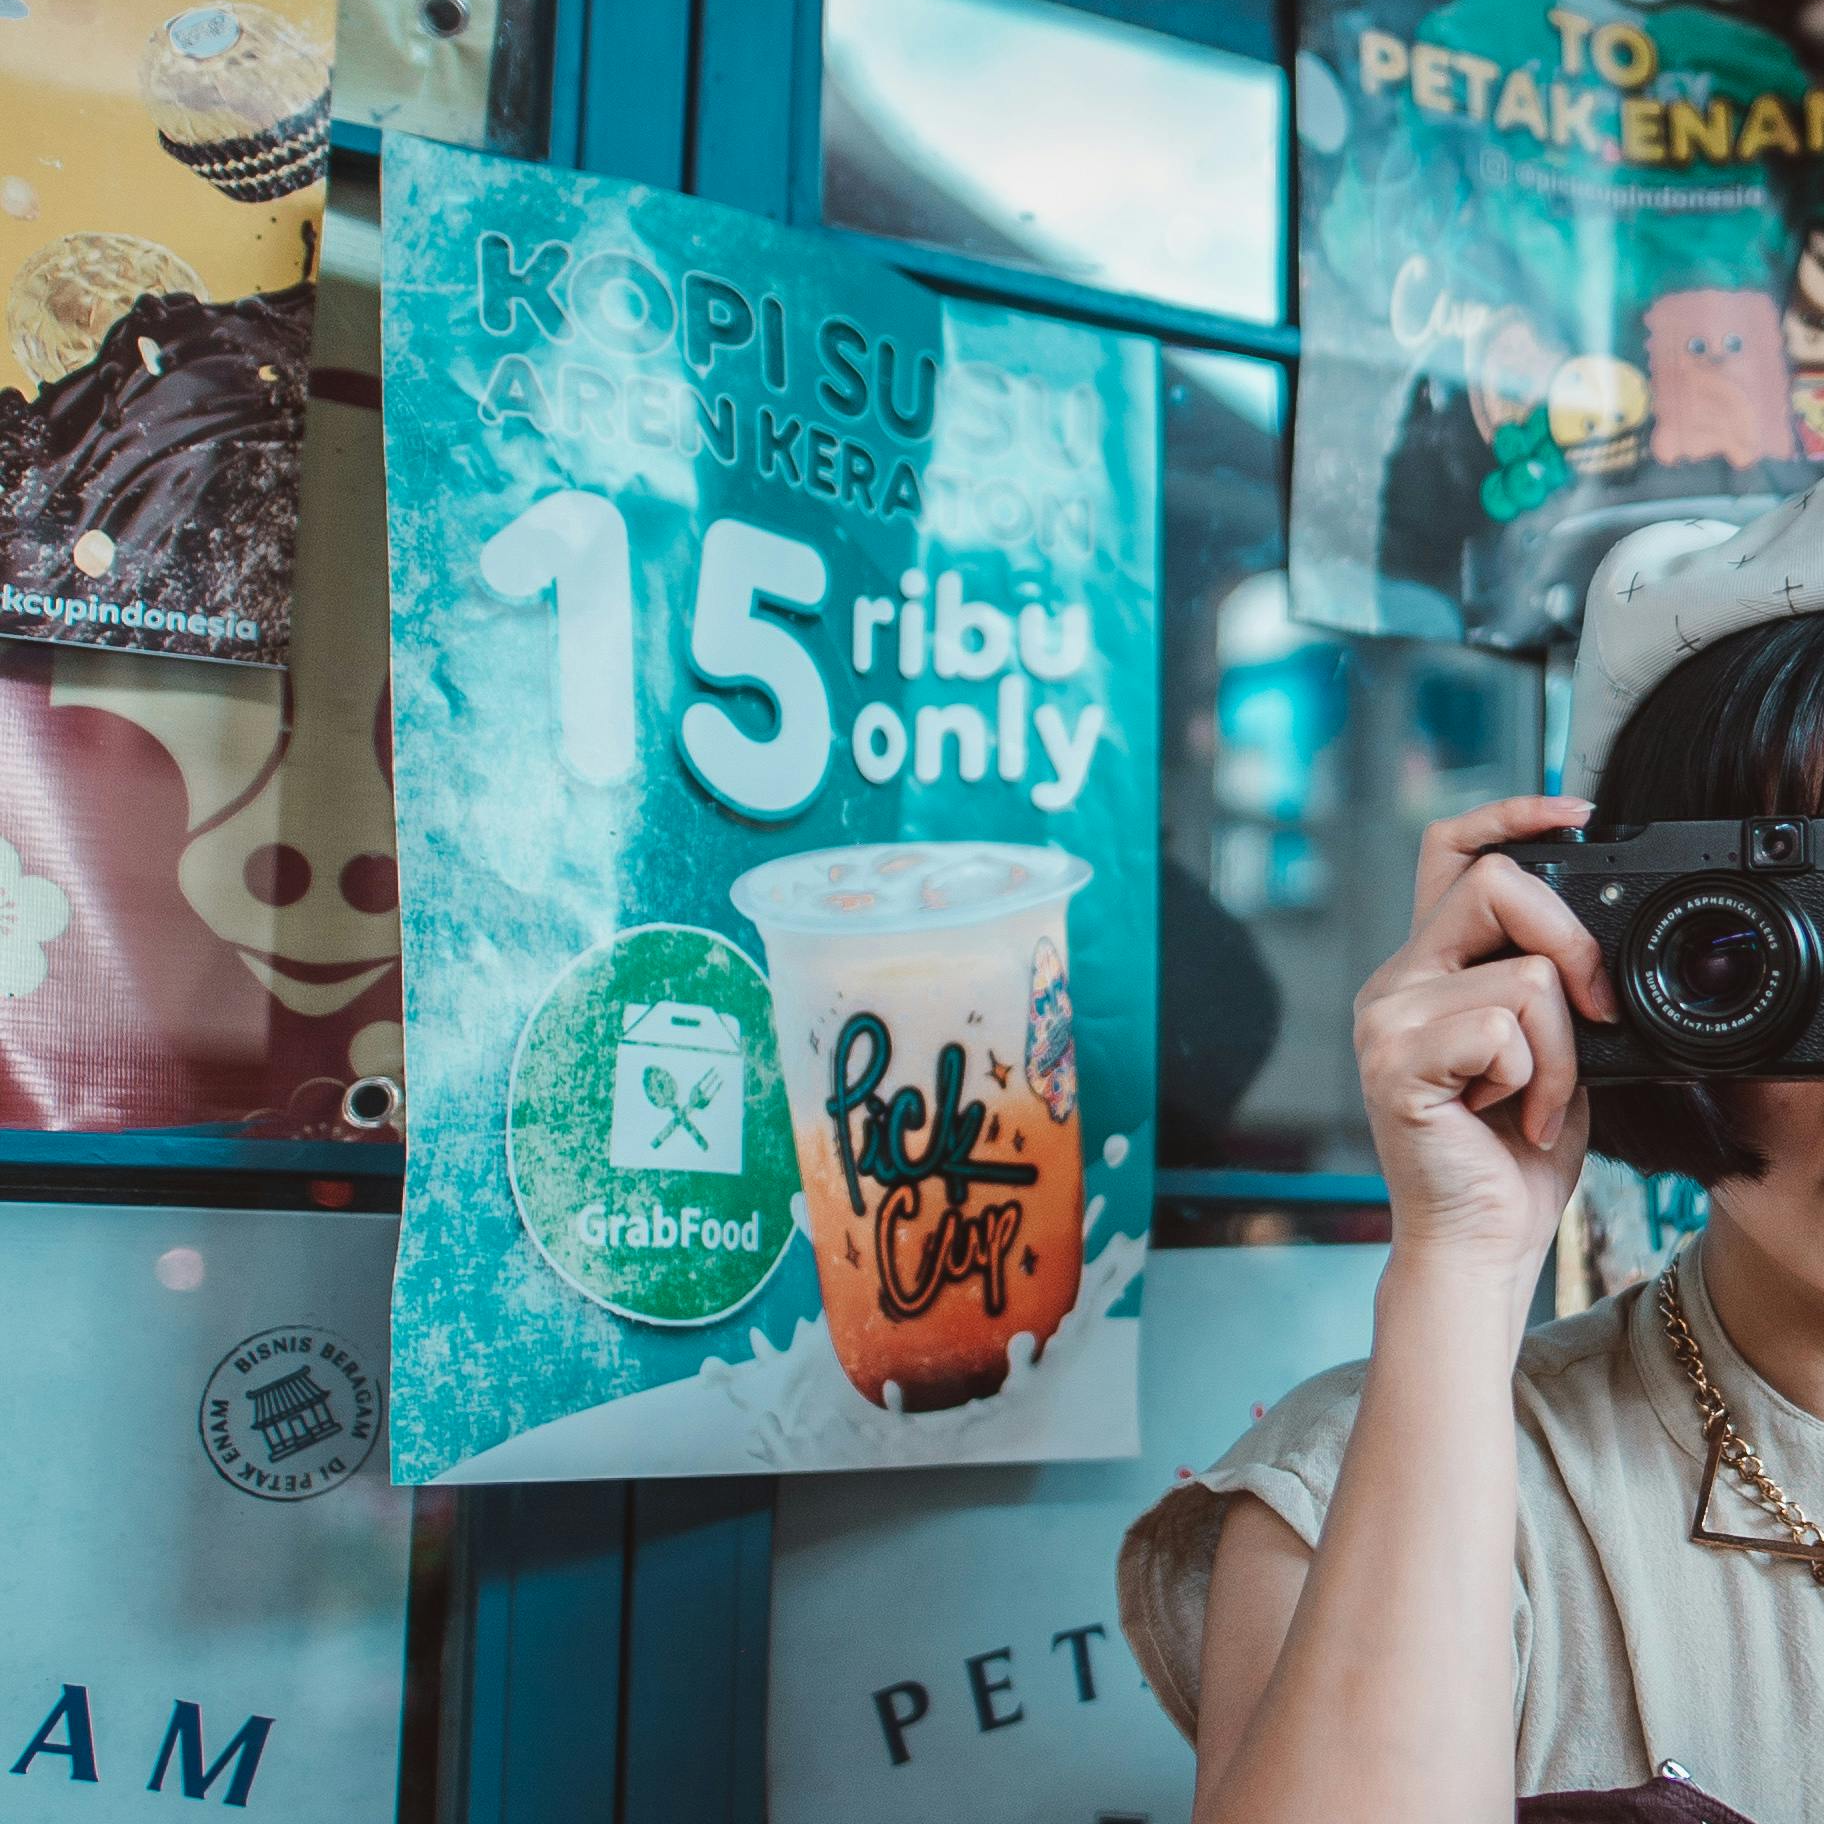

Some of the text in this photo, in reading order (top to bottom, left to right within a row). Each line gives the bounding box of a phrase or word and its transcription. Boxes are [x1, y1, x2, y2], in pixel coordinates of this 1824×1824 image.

[1359, 29, 1602, 154] PETAK
[1549, 5, 1657, 88] TO
[477, 231, 788, 392] KOPI
[477, 352, 738, 466] AREN
[480, 490, 830, 820] 15
[851, 567, 1088, 679] ribu
[851, 676, 1103, 811] only
[1647, 896, 1779, 951] FUJINON ASPHERICAL LENS
[1645, 970, 1664, 1005] SUPER
[1662, 1004, 1681, 1022] EBC
[827, 1011, 1038, 1218] Pick
[576, 1206, 760, 1253] GrabFood
[876, 1178, 1023, 1321] Cup
[210, 1399, 346, 1492] DI PETAK ENAM
[234, 1336, 373, 1440] BISNIS BERAGAM
[9, 1683, 276, 1808] AM
[872, 1622, 1150, 1766] PET
